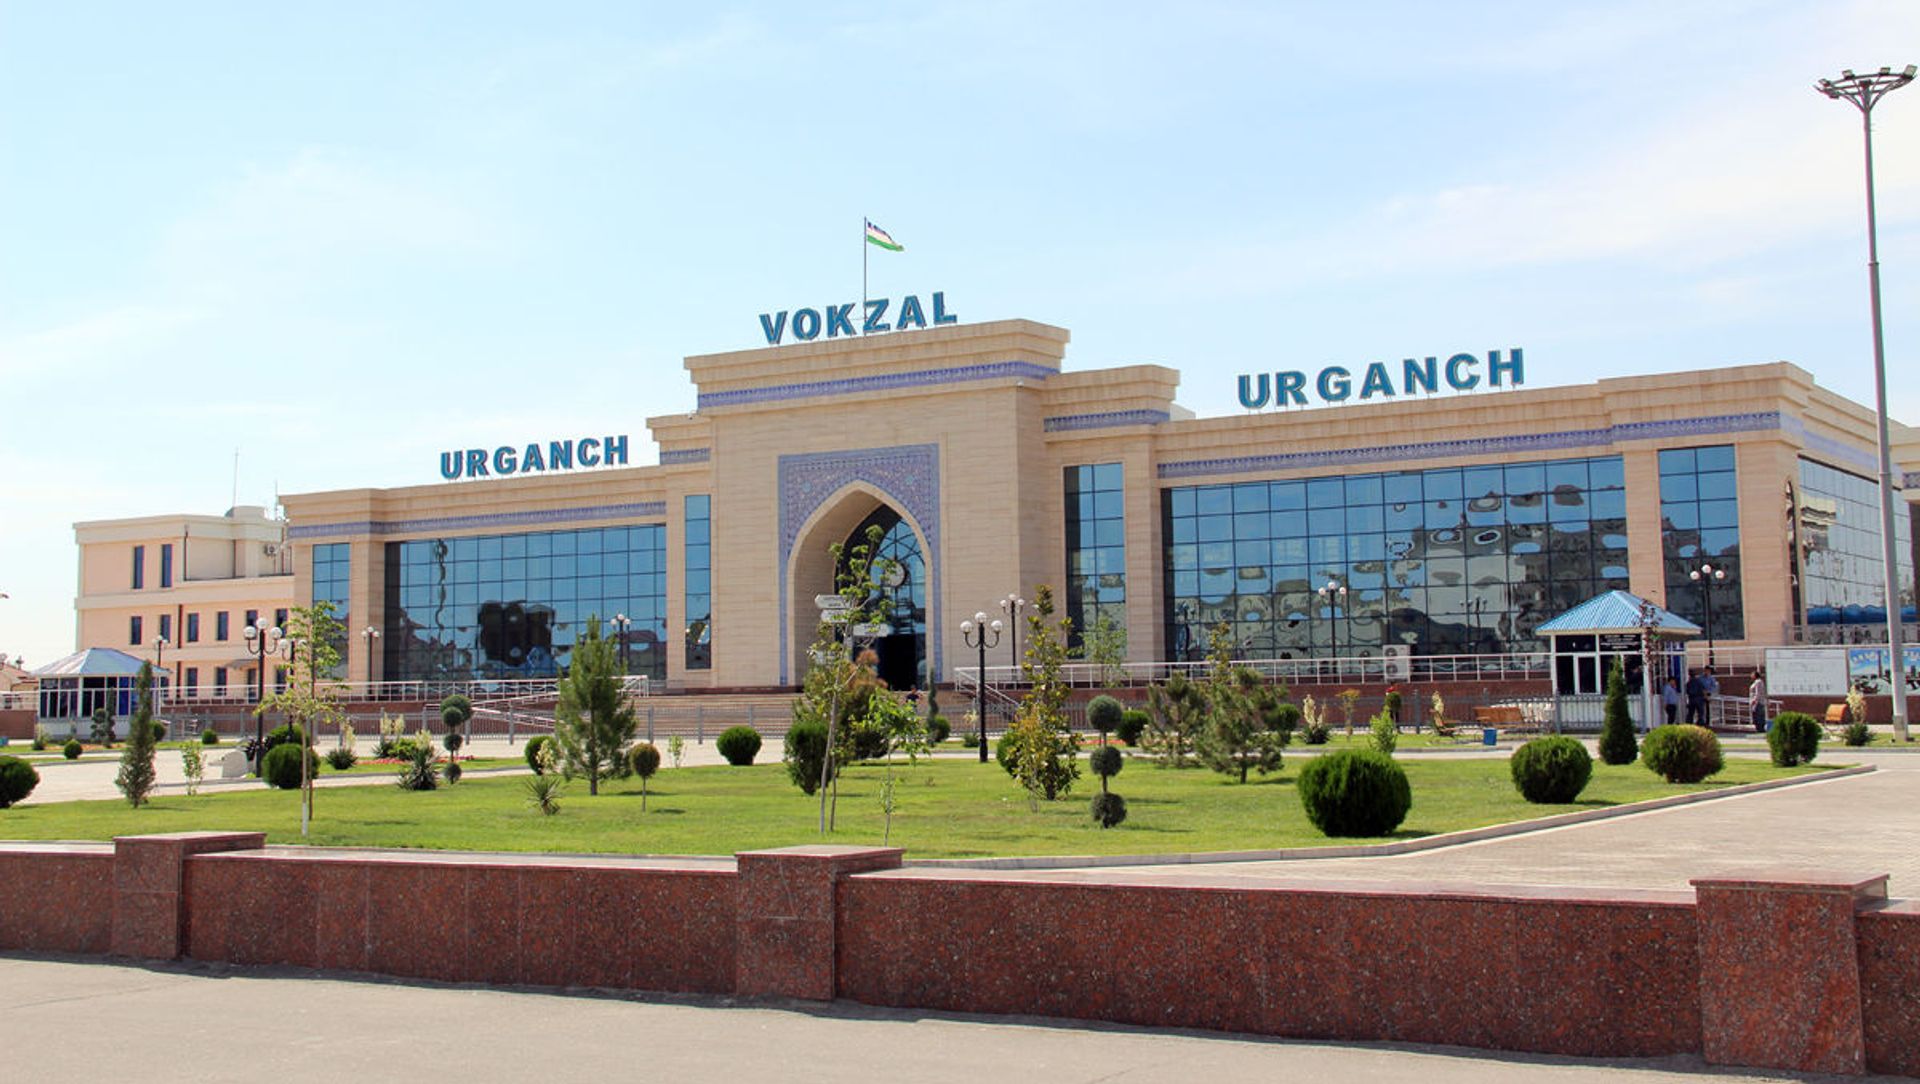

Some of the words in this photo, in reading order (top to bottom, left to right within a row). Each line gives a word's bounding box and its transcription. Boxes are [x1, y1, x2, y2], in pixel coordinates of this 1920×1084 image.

[759, 292, 957, 344] VOKZAL
[1237, 348, 1524, 409] URGANCH
[440, 435, 628, 479] URGANCH
